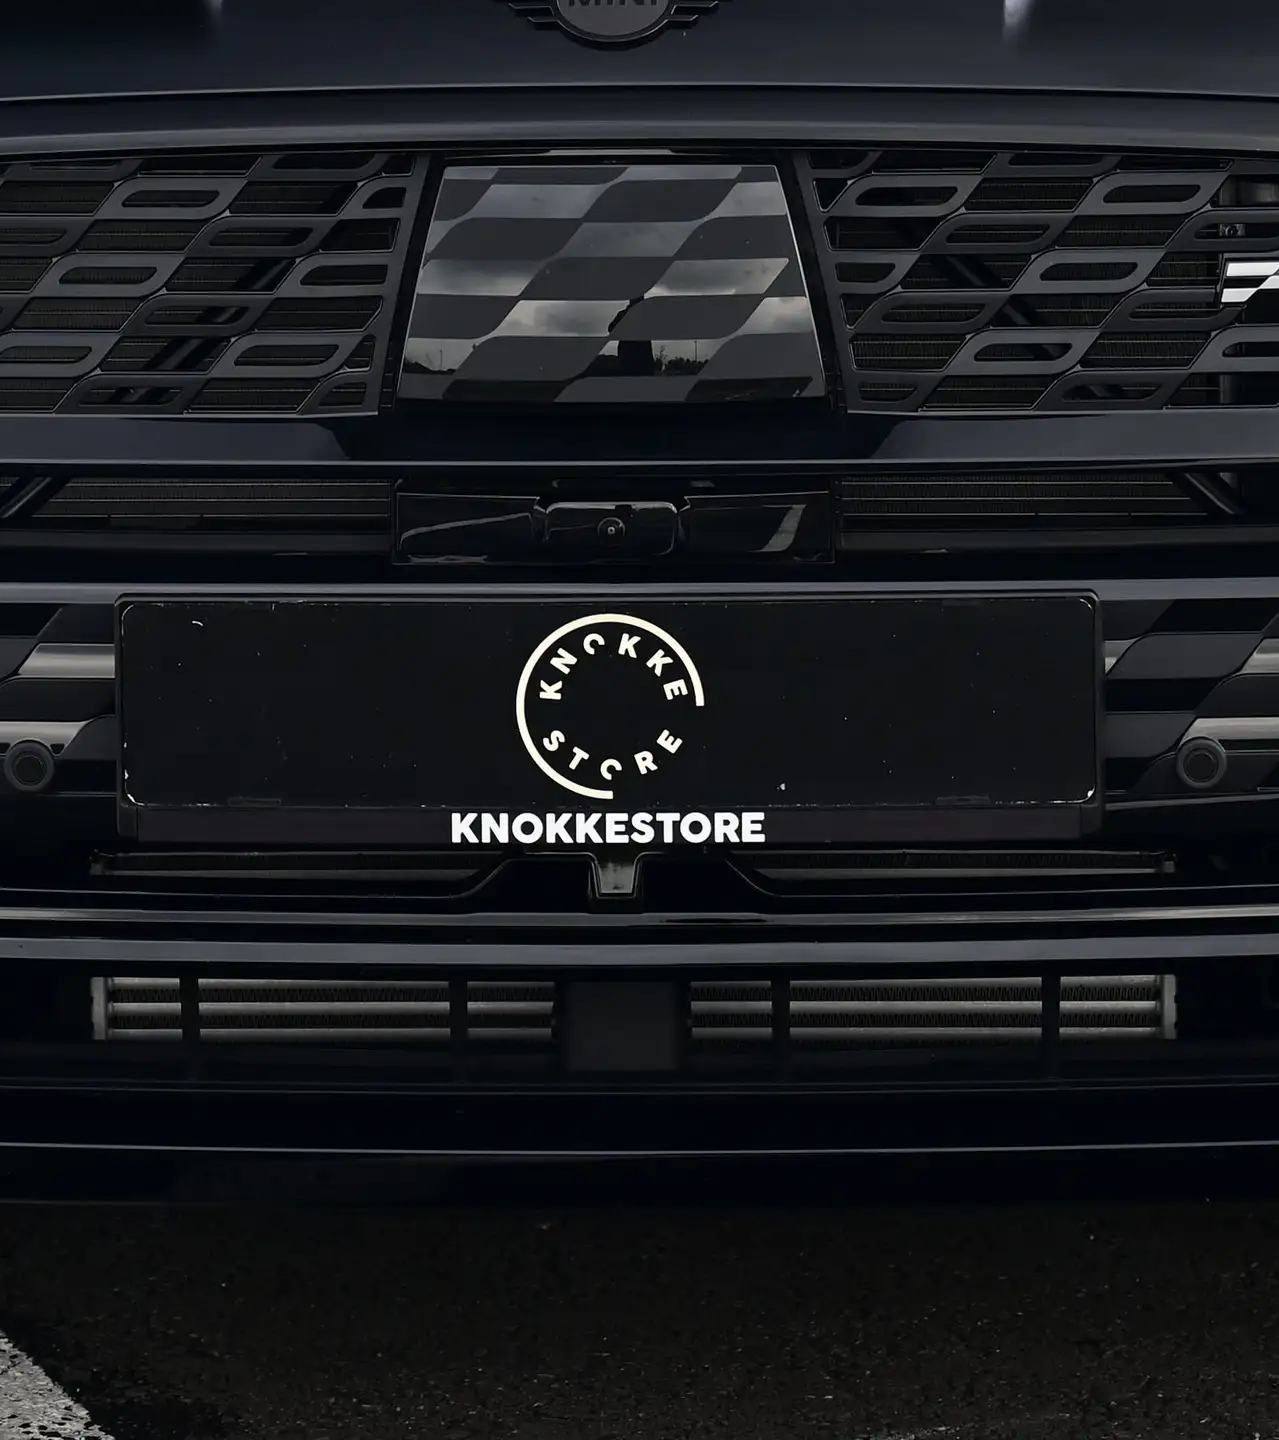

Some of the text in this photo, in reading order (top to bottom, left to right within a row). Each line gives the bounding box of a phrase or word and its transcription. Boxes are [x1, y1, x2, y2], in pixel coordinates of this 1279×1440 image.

[539, 633, 689, 700] KNOKKE
[542, 729, 683, 781] STORE
[451, 812, 766, 844] KNOKKESTORE
